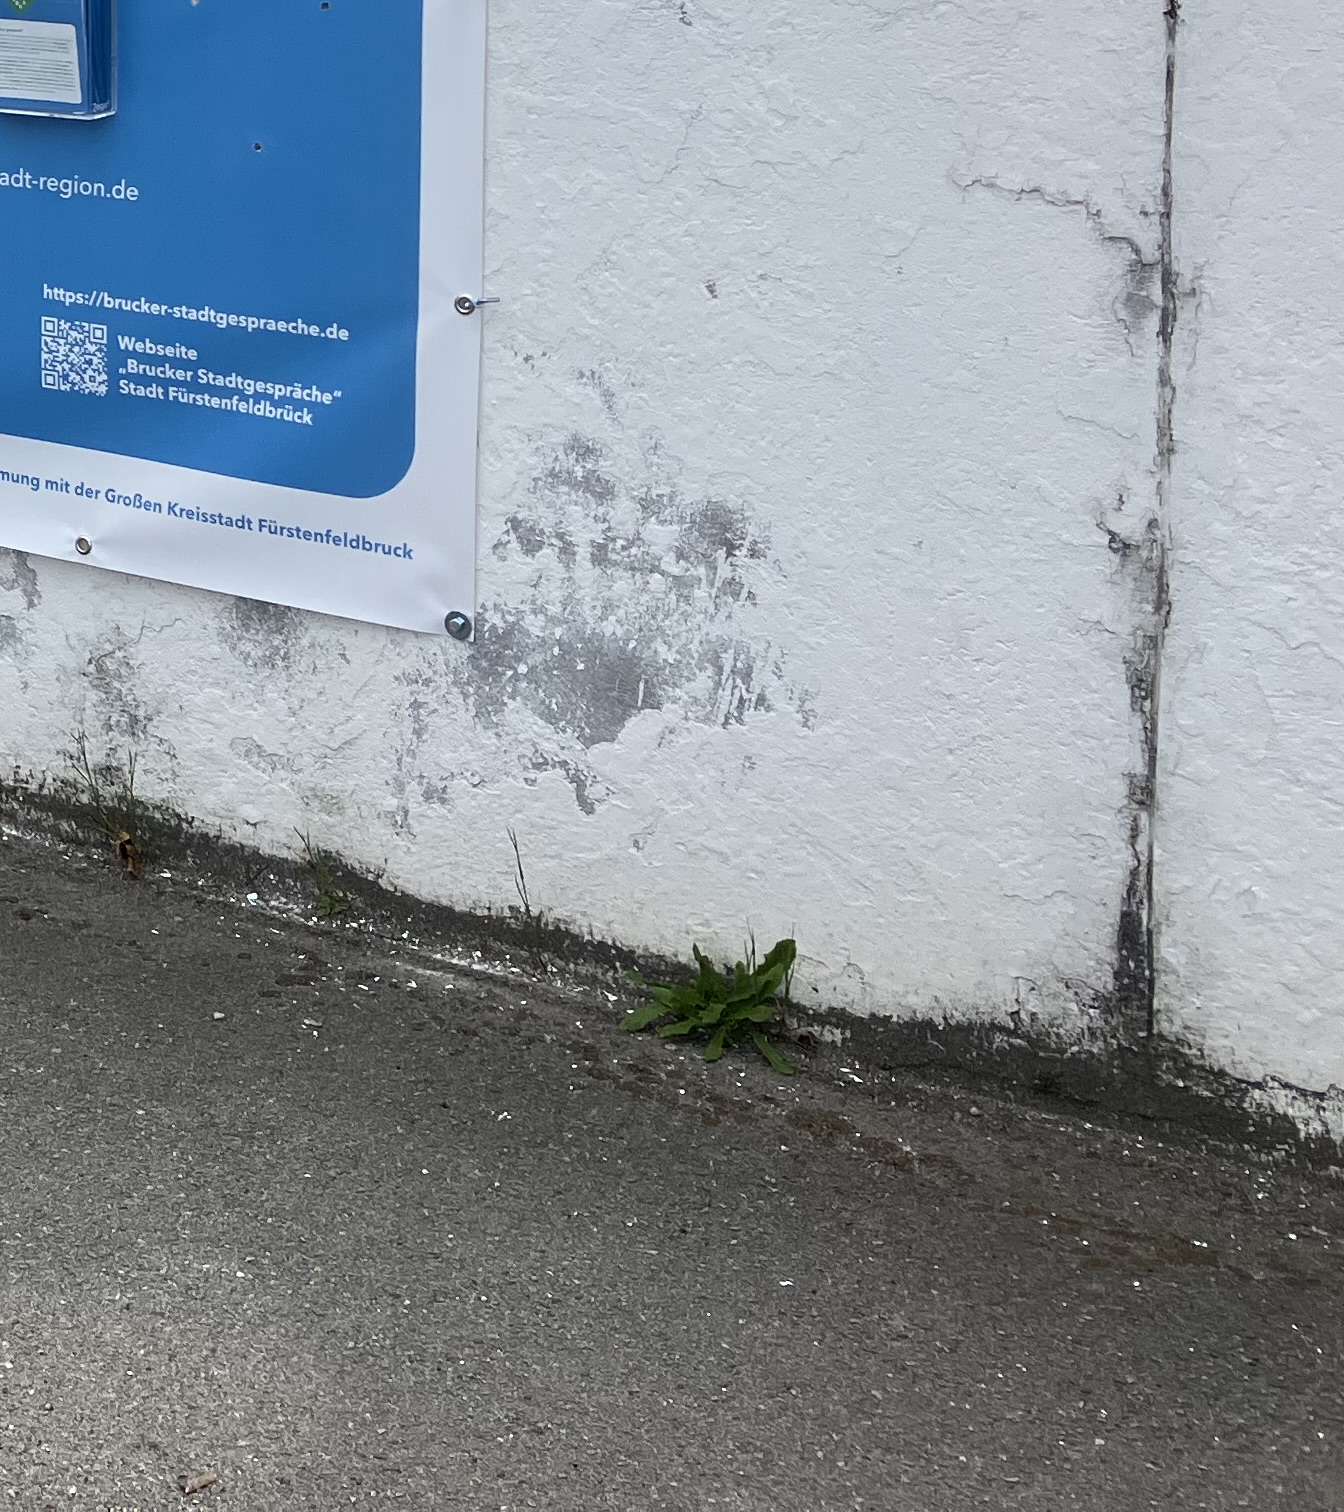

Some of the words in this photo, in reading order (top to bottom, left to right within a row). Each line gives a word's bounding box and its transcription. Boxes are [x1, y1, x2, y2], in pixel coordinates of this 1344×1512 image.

[43, 283, 348, 340] https://brucker-stadtgespraeche.de
[117, 335, 197, 360] Webseite
[119, 379, 164, 399] Stadt
[169, 386, 312, 425] Fürstenfeldbrück
[45, 478, 70, 493] mit
[74, 482, 100, 499] der
[105, 488, 161, 513] Großen
[168, 501, 252, 531] Kreisstadt
[258, 518, 412, 559] Fürstenfeldbruck
